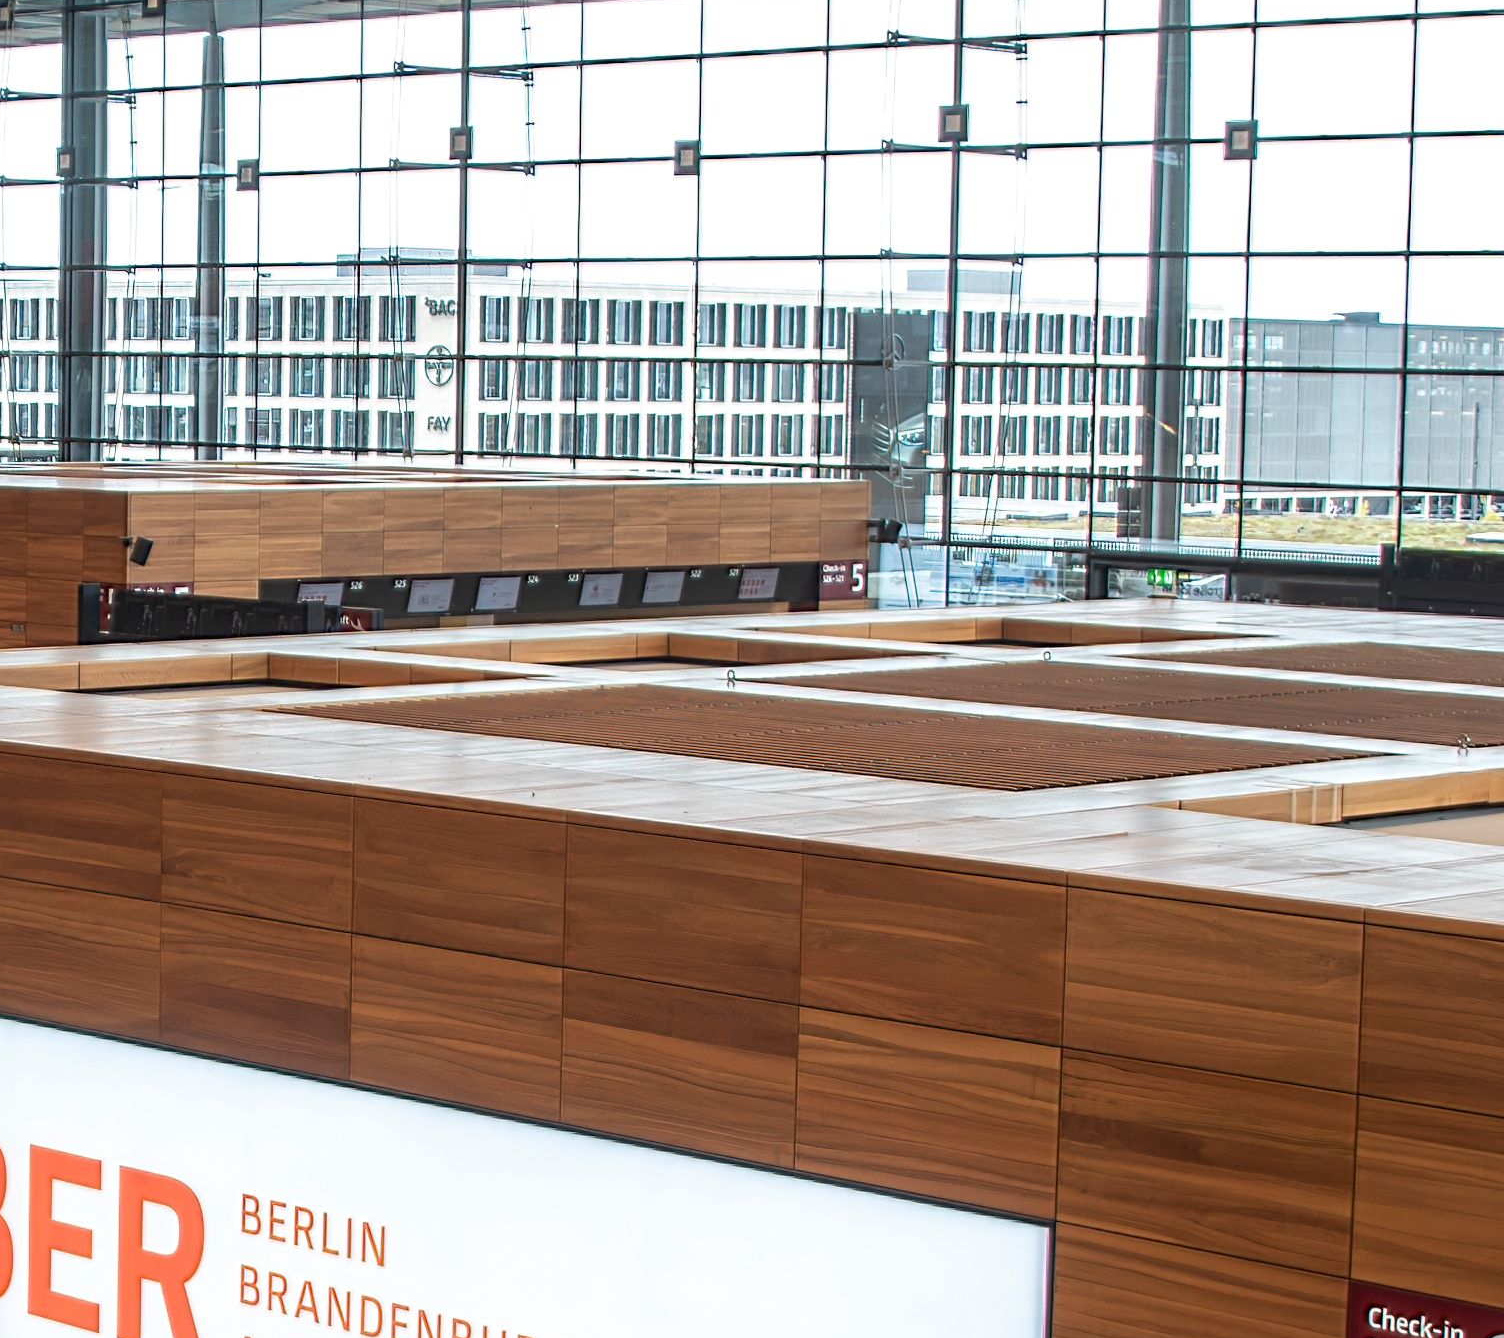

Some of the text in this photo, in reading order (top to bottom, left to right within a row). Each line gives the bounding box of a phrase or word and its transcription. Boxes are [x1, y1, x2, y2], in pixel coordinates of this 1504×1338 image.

[427, 416, 451, 432] FAY
[851, 563, 864, 593] 5
[241, 1192, 386, 1268] BERLIN
